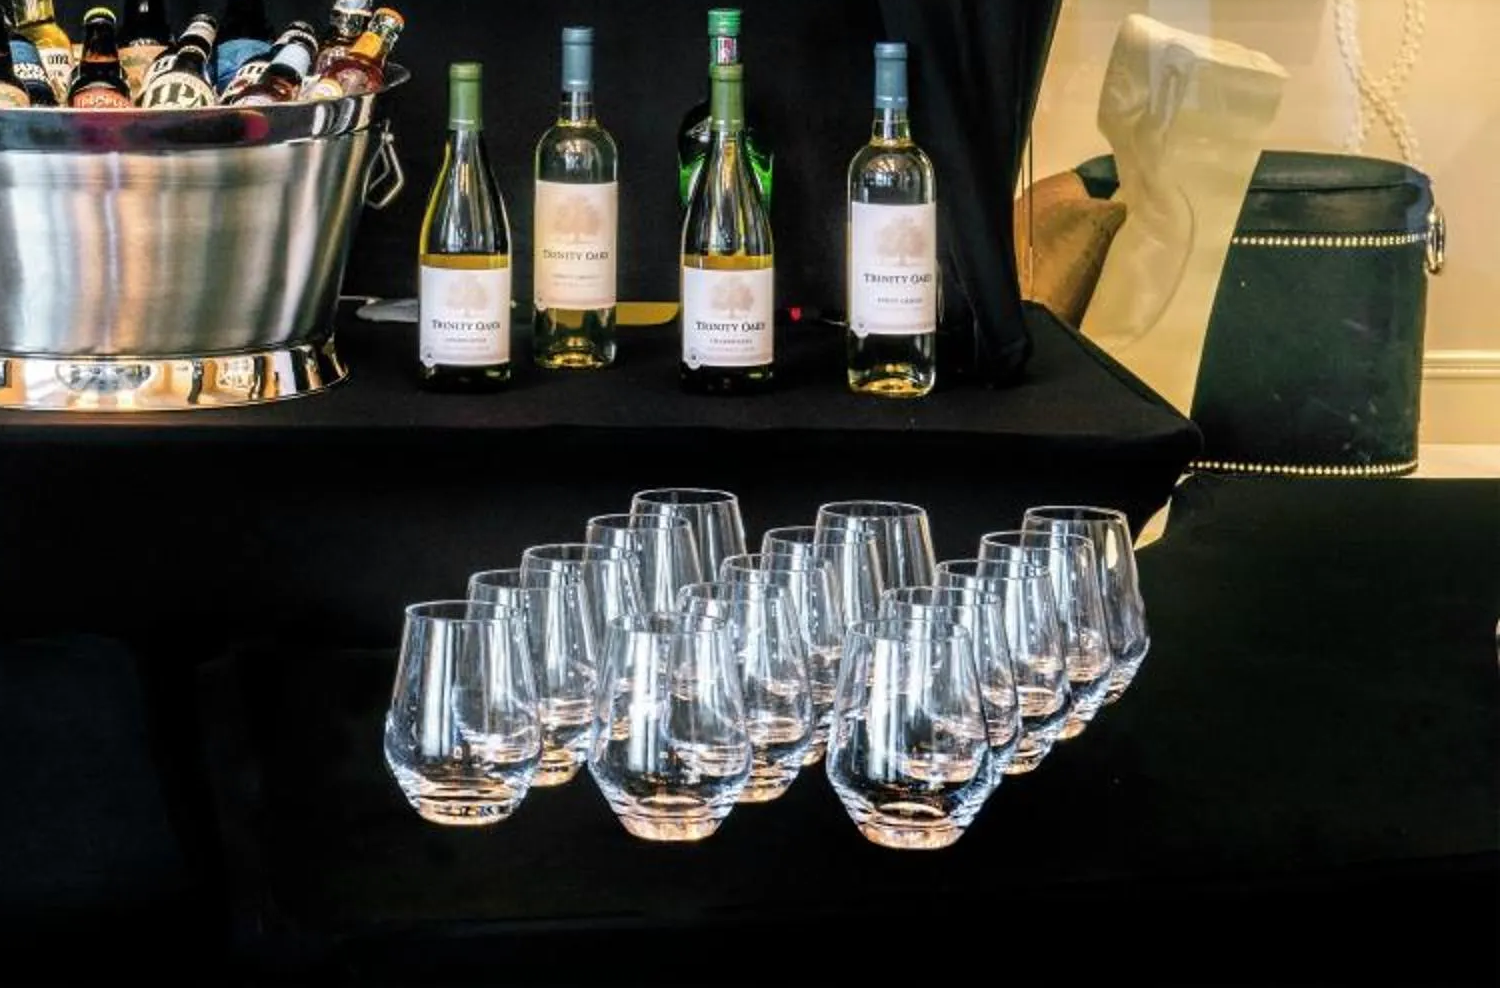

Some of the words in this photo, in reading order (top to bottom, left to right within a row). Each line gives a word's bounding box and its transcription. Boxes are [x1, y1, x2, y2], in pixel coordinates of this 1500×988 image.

[863, 272, 908, 284] TRINITY
[431, 319, 473, 331] TRINITY
[695, 321, 738, 332] TRINITY
